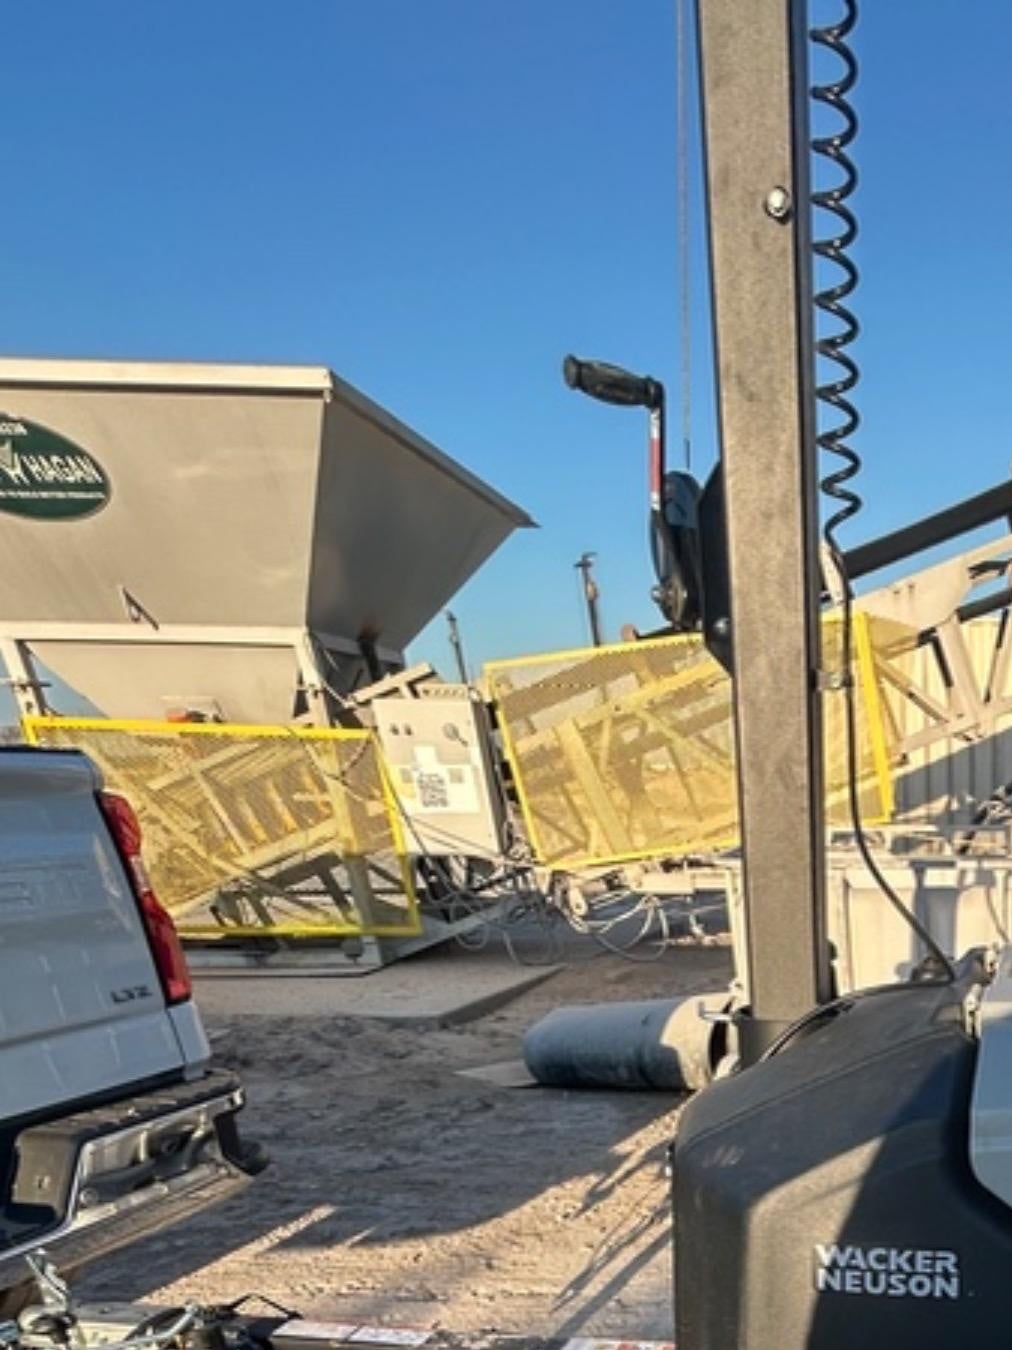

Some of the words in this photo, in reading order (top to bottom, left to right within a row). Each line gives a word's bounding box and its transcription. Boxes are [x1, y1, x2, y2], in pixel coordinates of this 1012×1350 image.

[21, 455, 103, 483] HAGAN
[814, 1243, 959, 1274] WACKER
[817, 1268, 960, 1298] NEUSON
